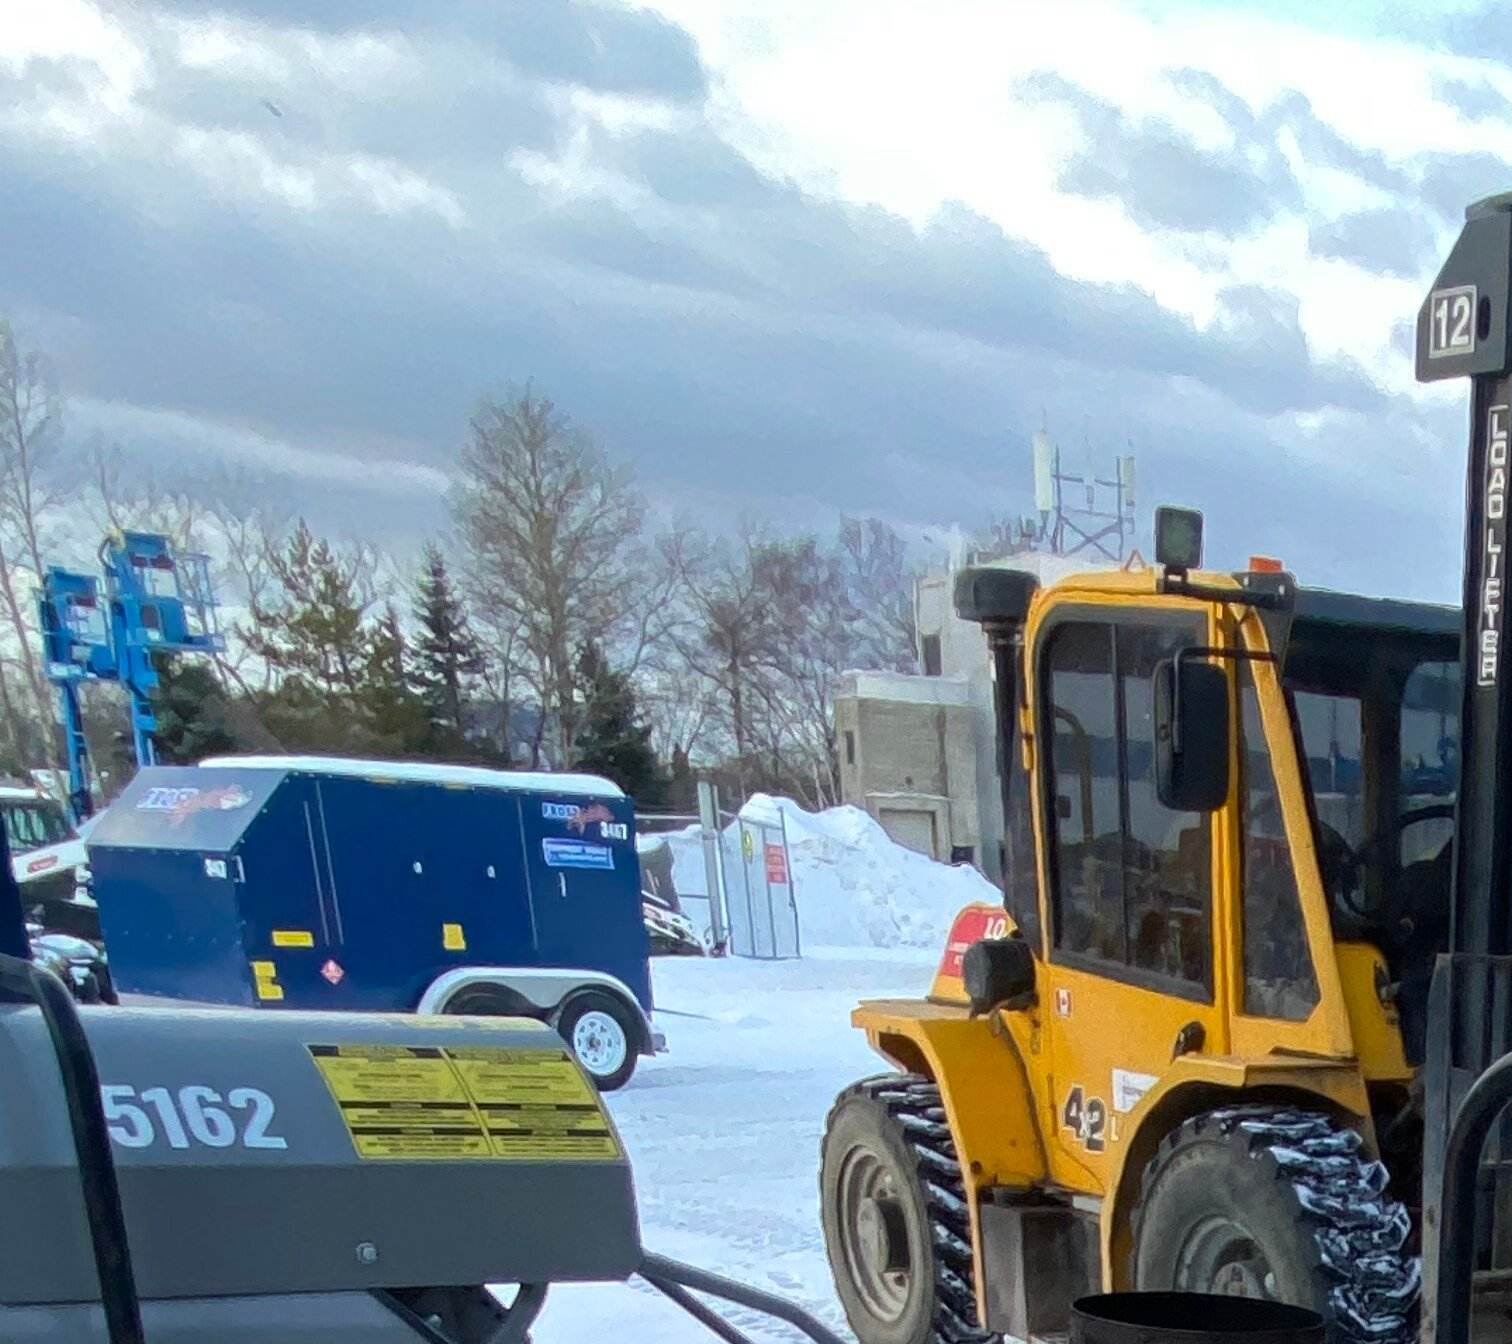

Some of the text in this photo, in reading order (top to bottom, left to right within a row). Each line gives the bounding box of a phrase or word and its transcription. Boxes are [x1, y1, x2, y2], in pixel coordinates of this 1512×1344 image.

[1435, 295, 1470, 349] 12
[1481, 413, 1508, 680] LOAD LIFTER
[101, 1084, 288, 1149] 5162
